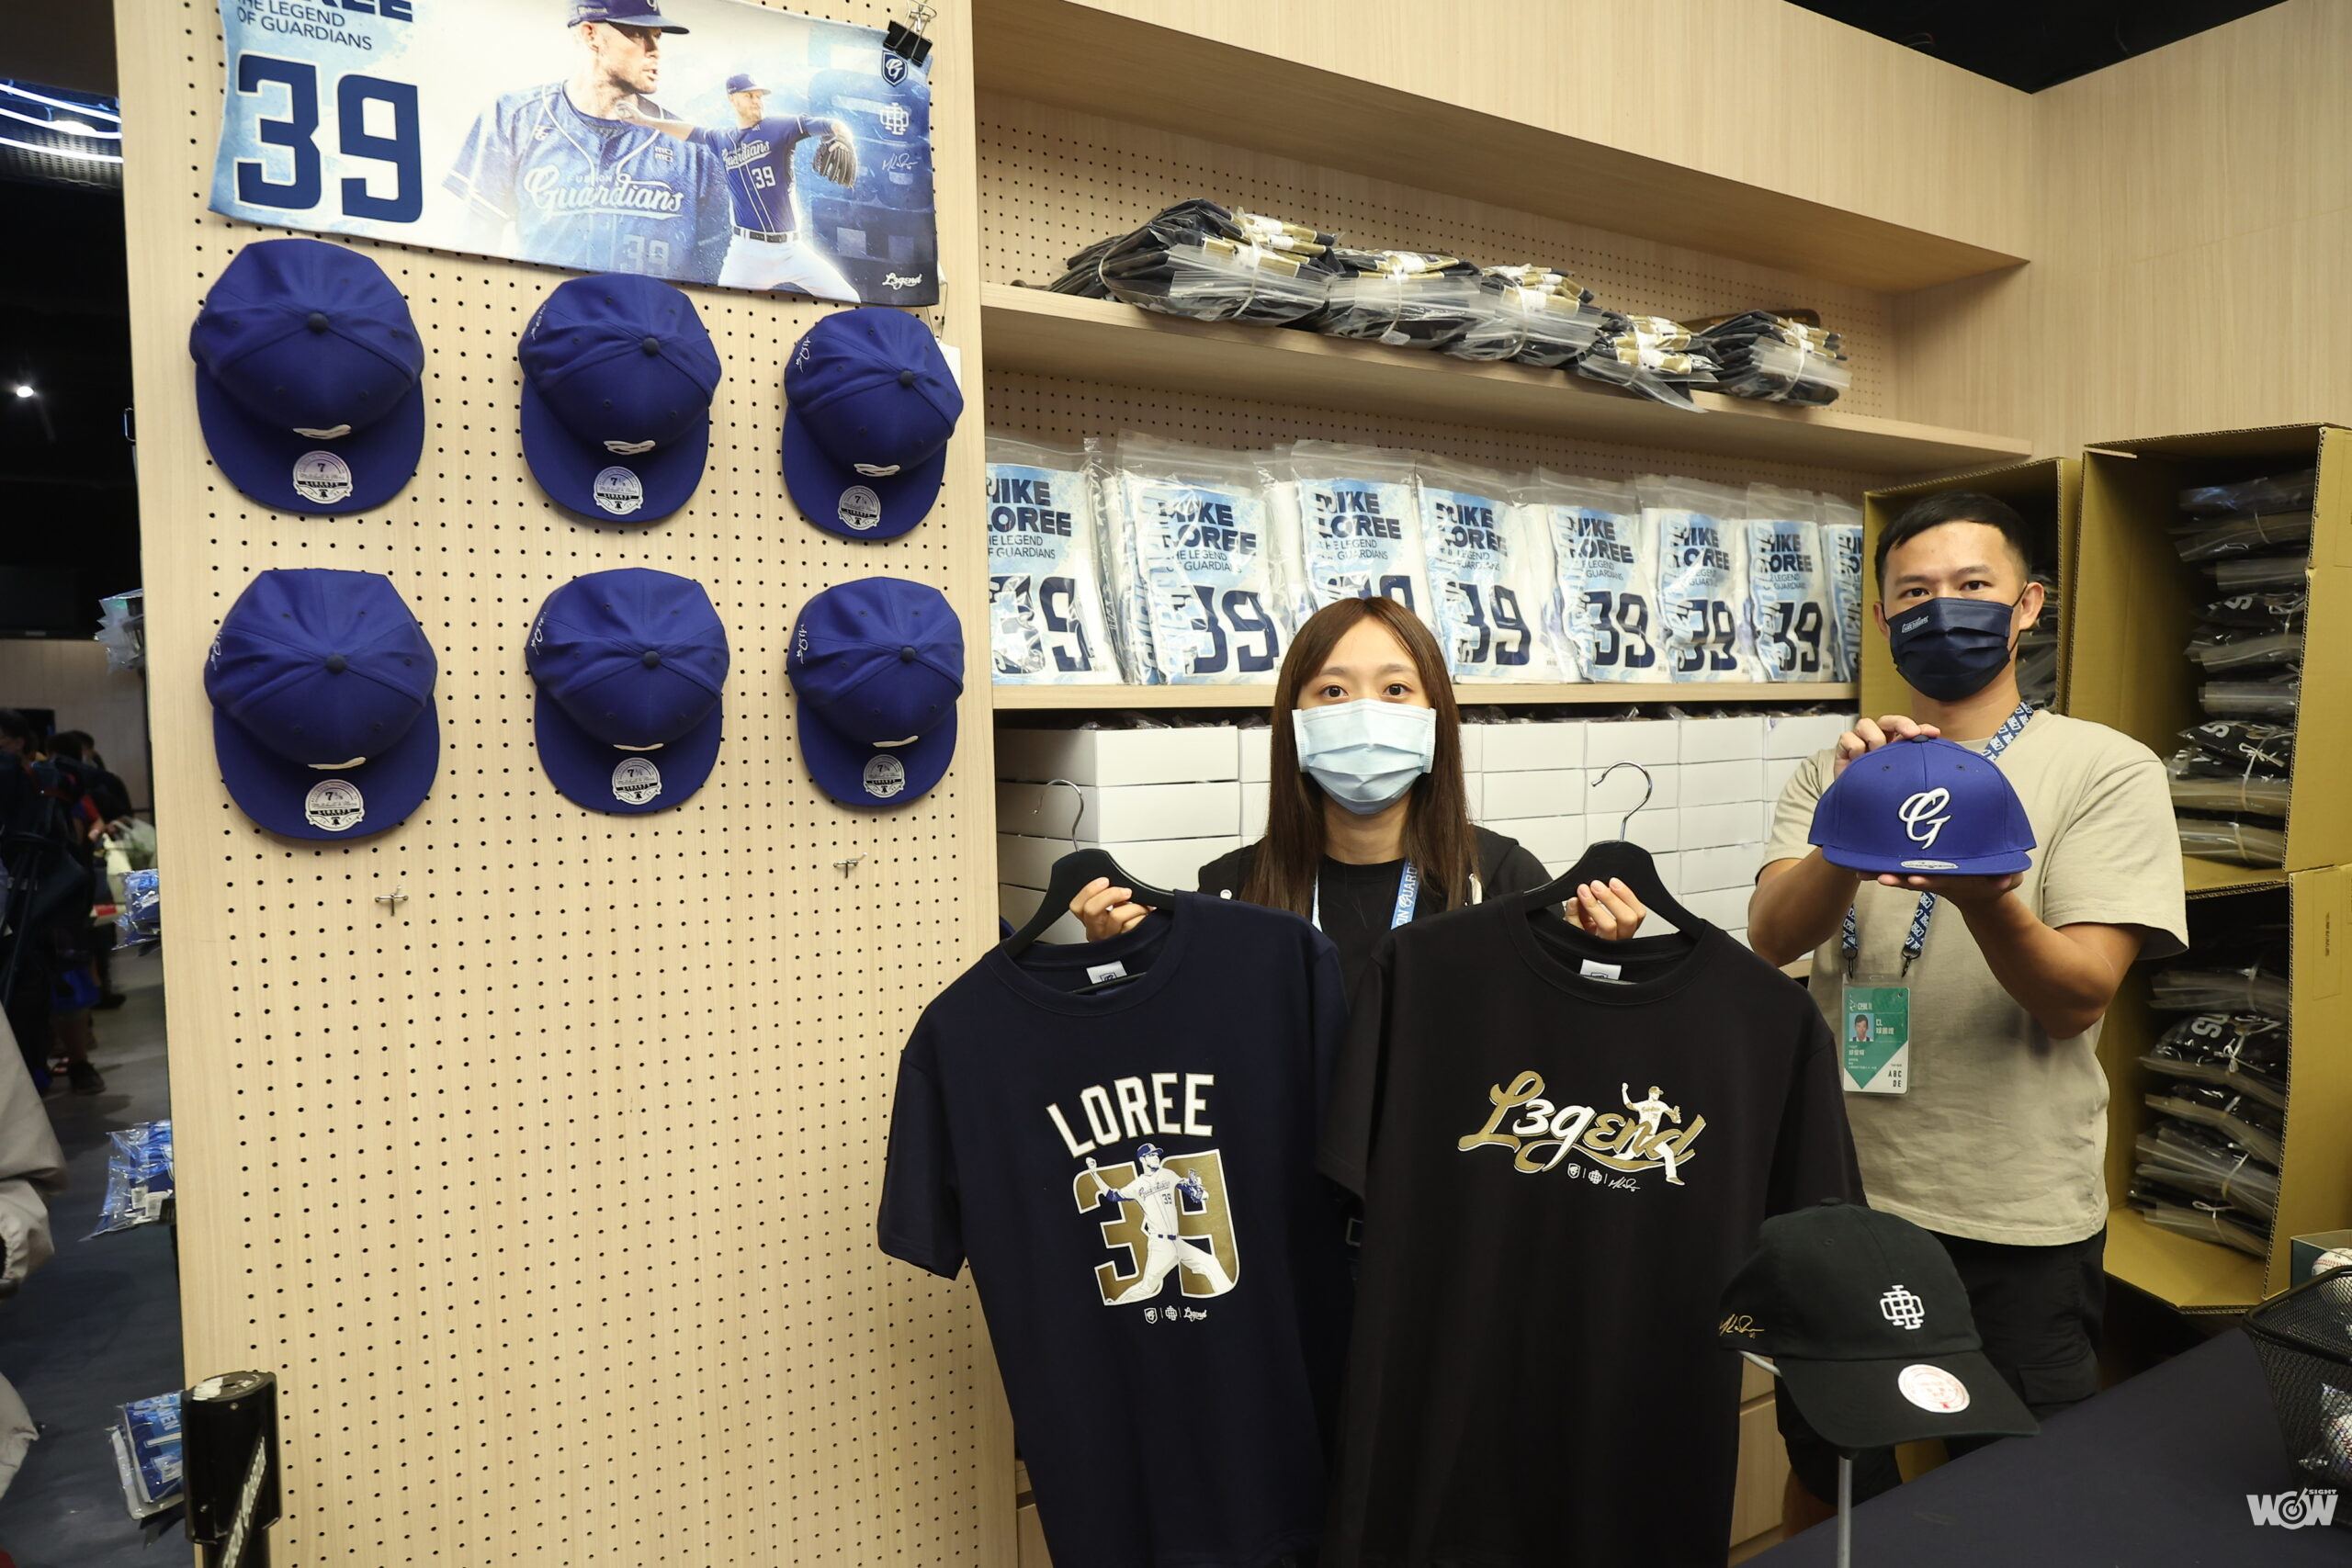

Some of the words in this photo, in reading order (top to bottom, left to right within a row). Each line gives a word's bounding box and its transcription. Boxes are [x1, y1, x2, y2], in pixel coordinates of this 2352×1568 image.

[237, 6, 256, 25] OF
[261, 16, 373, 51] GUARDIANS
[269, 0, 345, 28] LEGEND
[237, 53, 423, 223] 39
[523, 164, 685, 222] Guardians
[751, 165, 776, 189] 39
[620, 233, 671, 274] 39
[988, 505, 1071, 537] OREE
[1001, 535, 1044, 547] LEGEND
[1162, 524, 1256, 556] OREE
[996, 547, 1056, 559] GUARDIANS
[1774, 602, 1823, 672] 39
[1897, 786, 1951, 850] G
[1046, 1072, 1215, 1158] LOREE
[1073, 1148, 1240, 1306] 39
